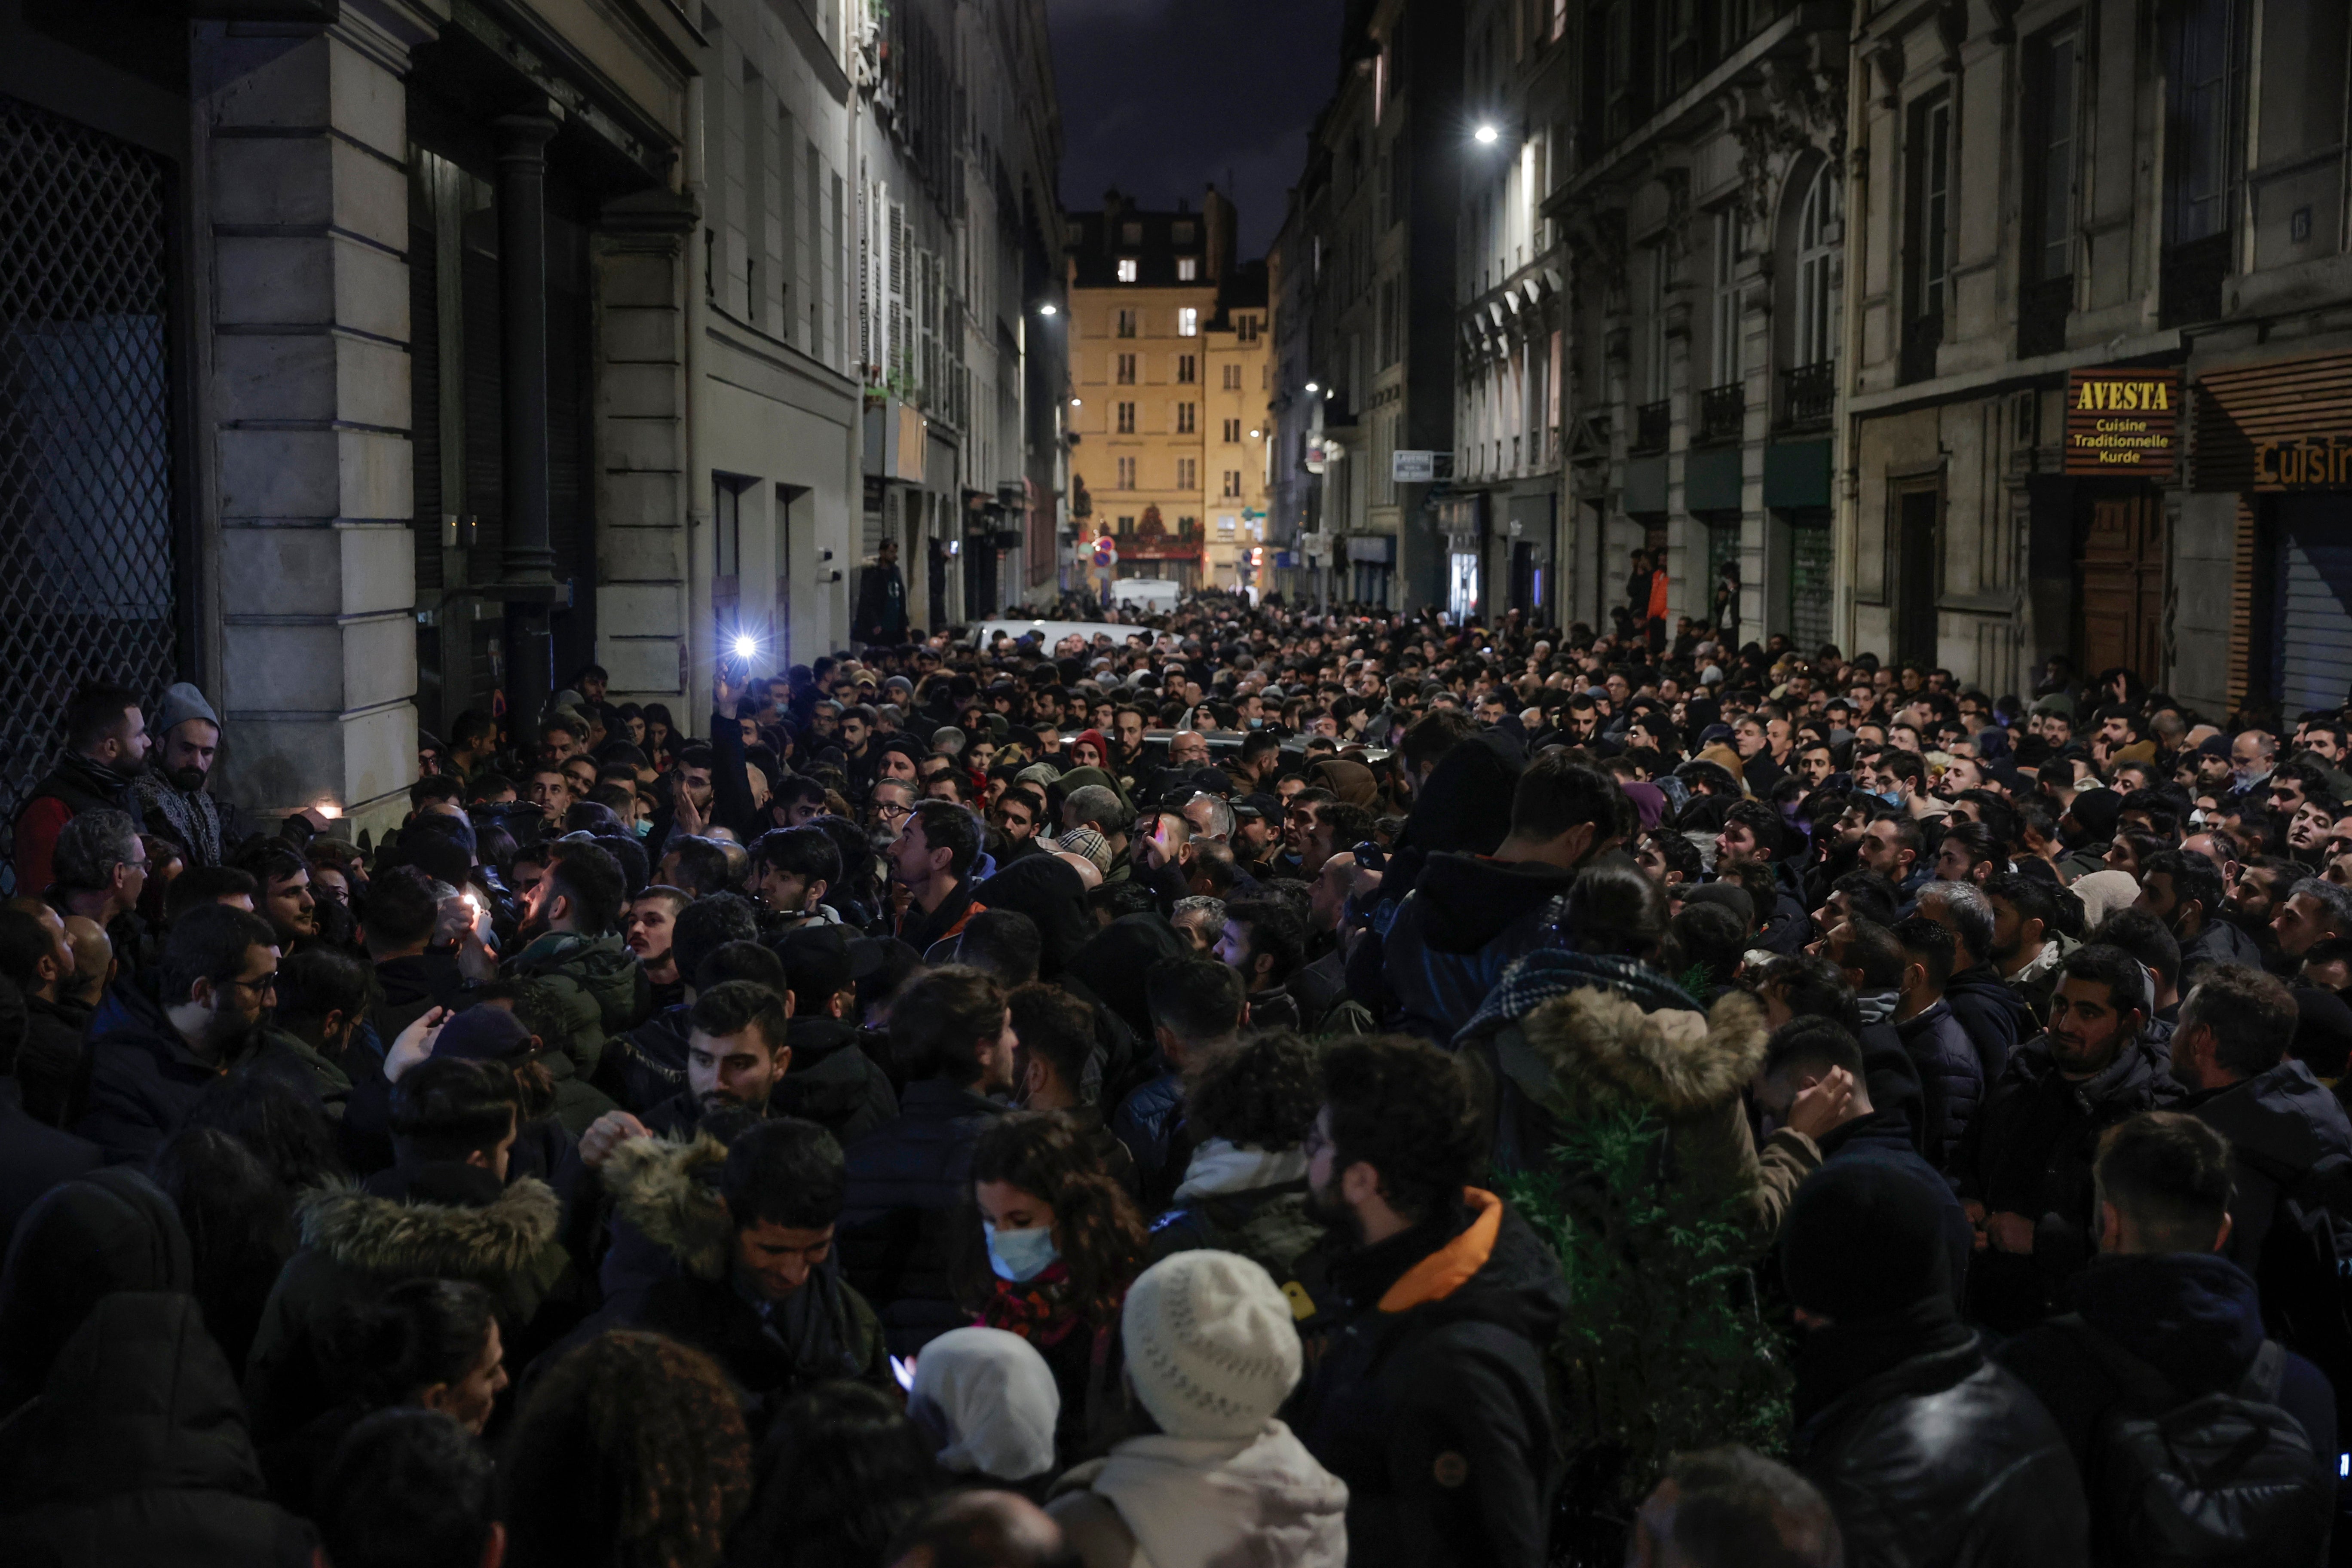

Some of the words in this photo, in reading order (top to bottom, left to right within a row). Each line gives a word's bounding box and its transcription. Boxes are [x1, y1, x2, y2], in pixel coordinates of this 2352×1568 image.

[2076, 382, 2168, 410] AVESTA
[2096, 419, 2147, 432] Cuisine
[2073, 434, 2168, 448] Traditionnelle
[2100, 450, 2141, 463] Kurde
